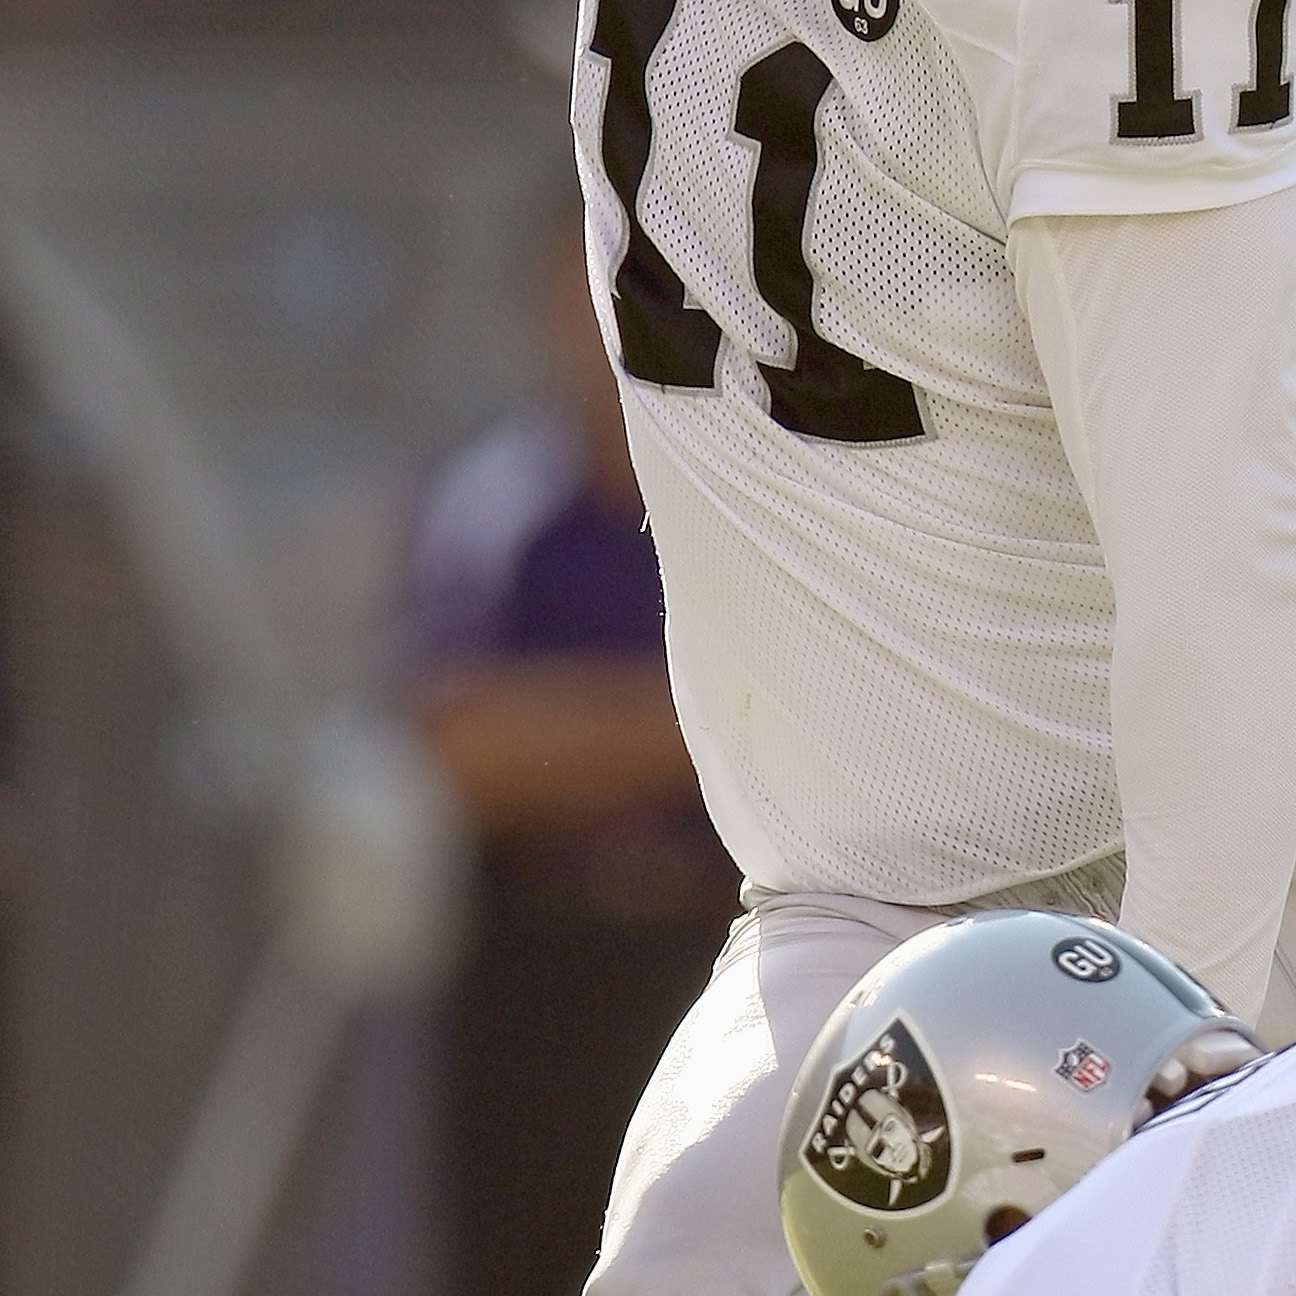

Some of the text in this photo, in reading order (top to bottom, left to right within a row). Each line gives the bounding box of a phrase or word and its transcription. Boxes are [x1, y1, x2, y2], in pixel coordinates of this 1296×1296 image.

[1058, 940, 1114, 977] GU
[1072, 1053, 1111, 1091] NFL
[811, 1033, 896, 1153] RAIDERS
